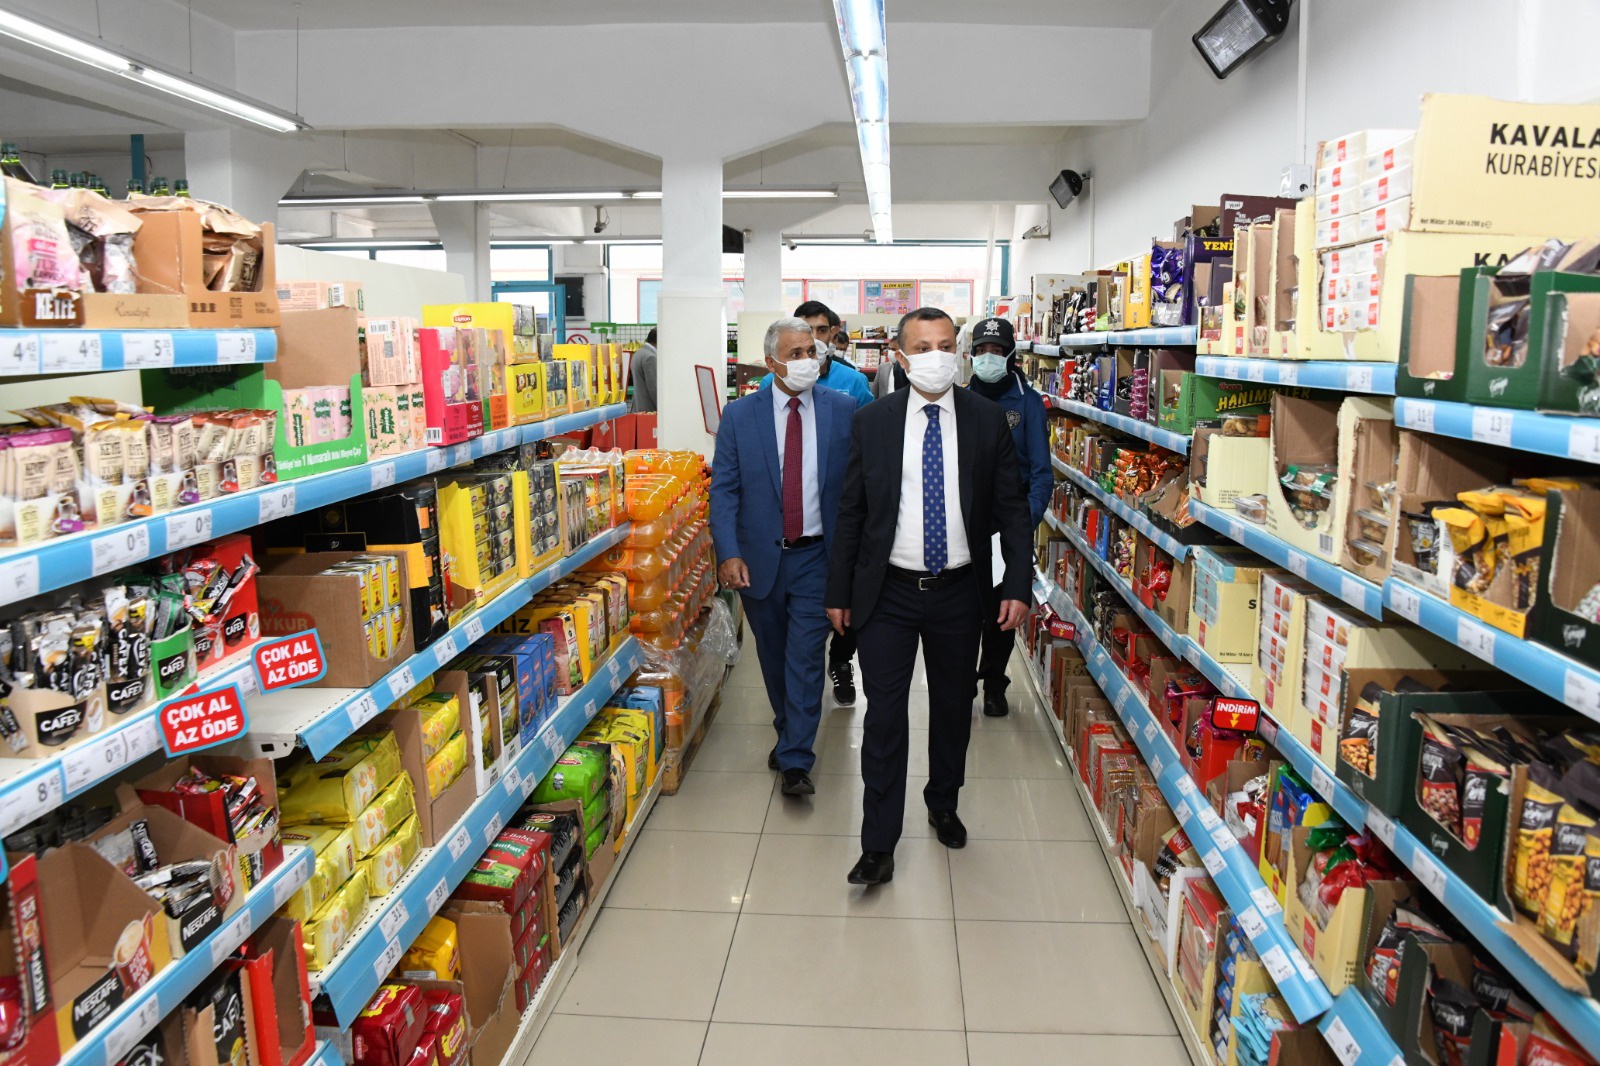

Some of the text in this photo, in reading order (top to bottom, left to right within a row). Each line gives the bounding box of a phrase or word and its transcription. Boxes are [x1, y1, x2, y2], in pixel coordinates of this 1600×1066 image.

[1490, 123, 1600, 149] KAVALA
[1486, 151, 1600, 179] KURABİYES
[1248, 599, 1257, 609] S
[256, 617, 308, 631] YKUR
[492, 615, 531, 634] LİZ
[194, 638, 211, 654] AFEX
[261, 639, 313, 669] ÇOK AL
[160, 658, 186, 677] CAFEX
[267, 659, 319, 685] AZ ÖDE
[110, 682, 144, 701] CAFEX
[40, 711, 82, 732] CAFEX
[166, 696, 232, 731] ÇOK AL
[174, 714, 239, 747] AZ ÖDE
[37, 782, 48, 802] 8
